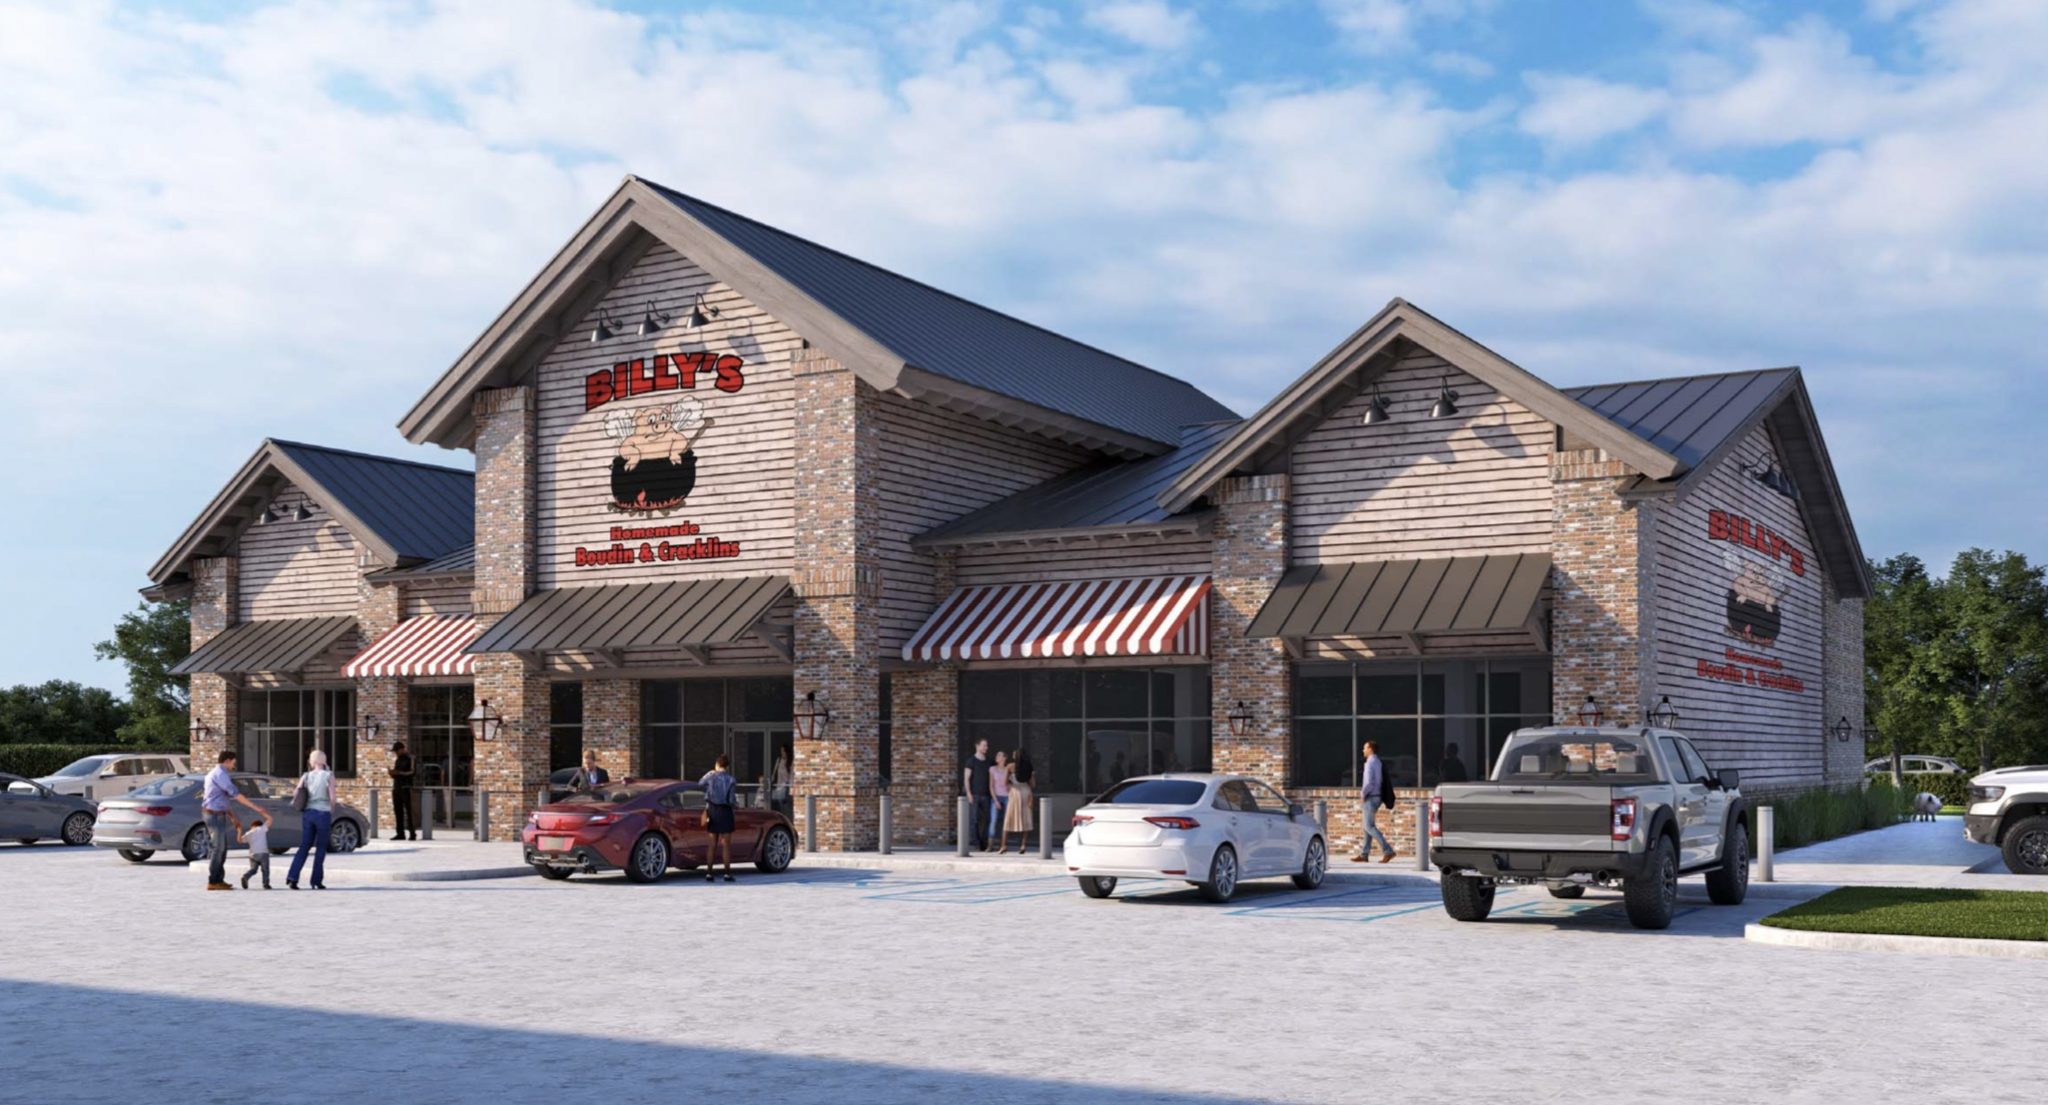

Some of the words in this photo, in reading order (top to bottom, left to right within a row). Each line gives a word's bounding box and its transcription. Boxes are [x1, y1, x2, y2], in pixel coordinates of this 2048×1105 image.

[586, 352, 744, 412] BILLY'S
[575, 543, 635, 567] Boudin
[638, 542, 656, 562] &
[658, 536, 741, 561] Cracklins
[610, 520, 700, 541] Homemade
[1708, 509, 1805, 577] BILLY'S
